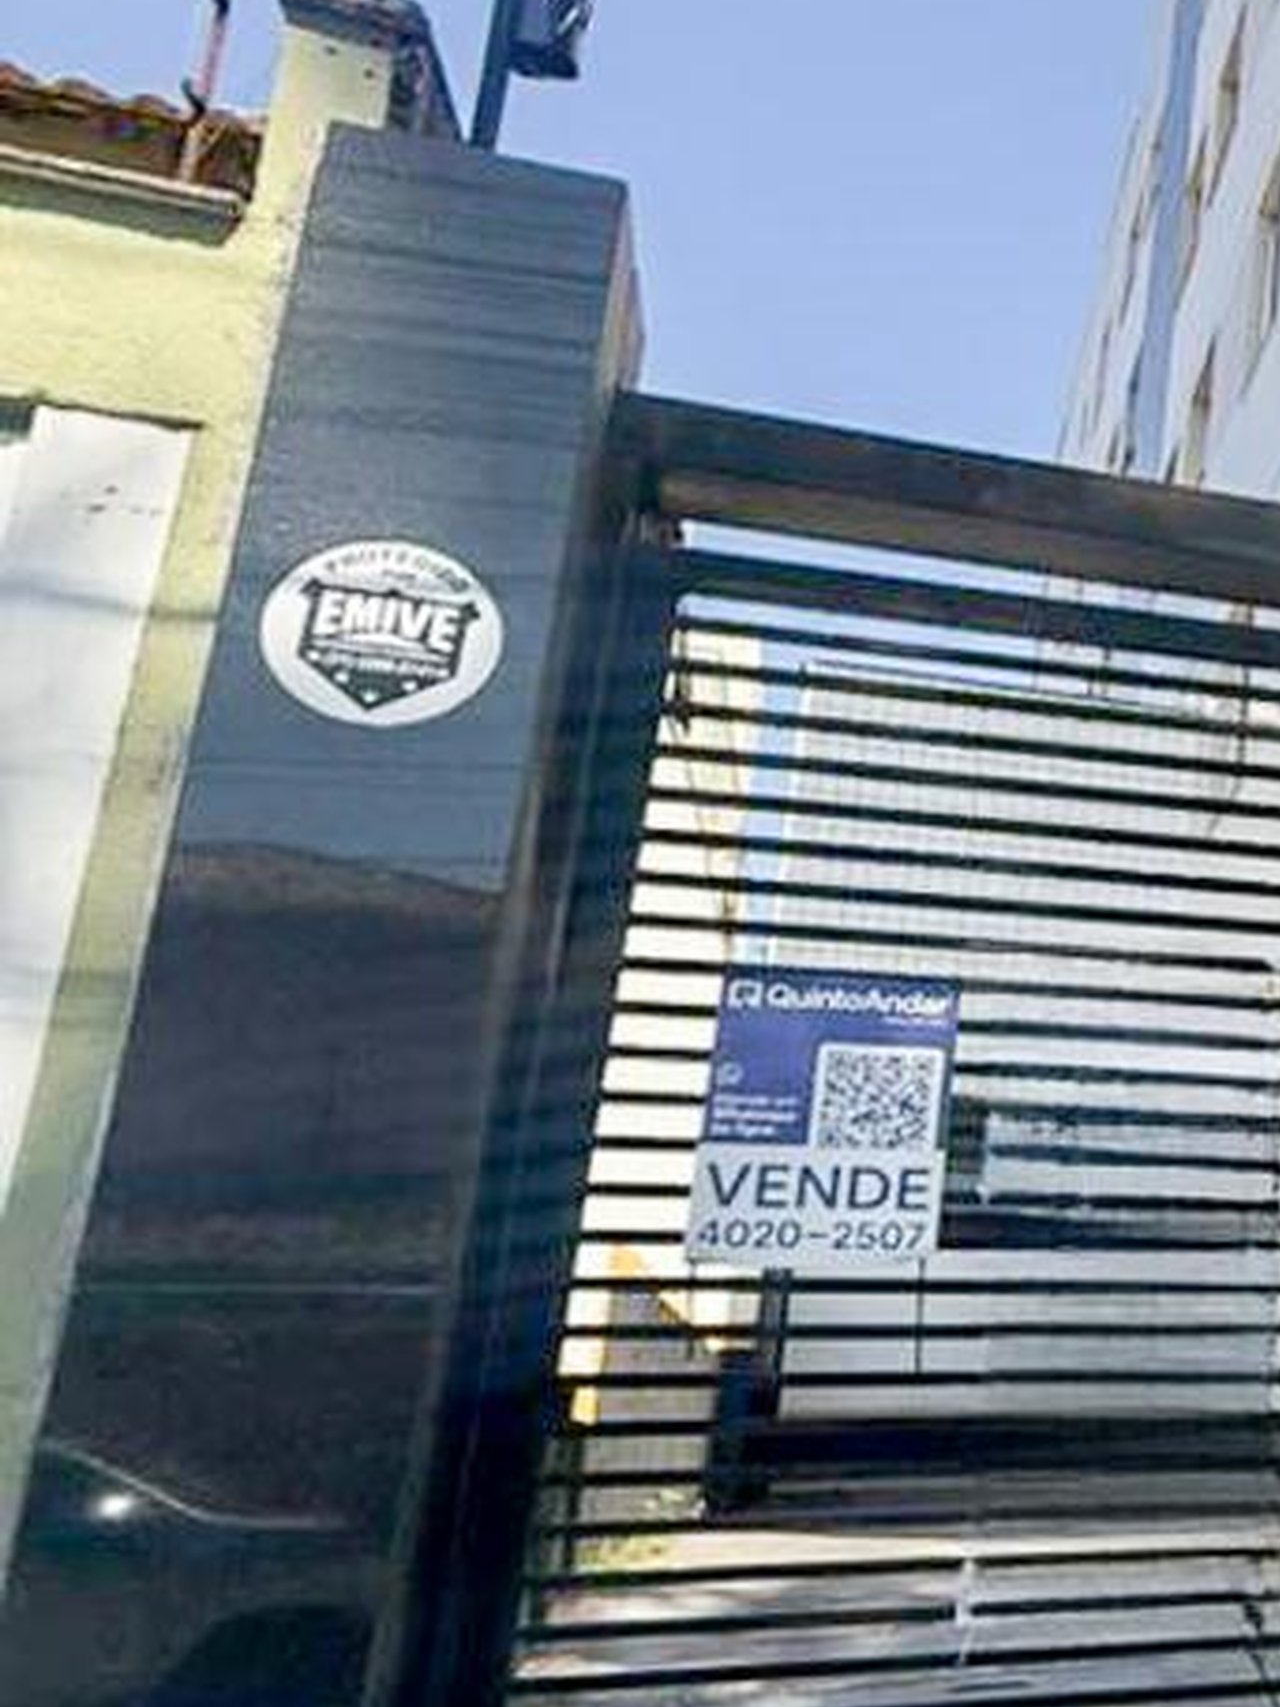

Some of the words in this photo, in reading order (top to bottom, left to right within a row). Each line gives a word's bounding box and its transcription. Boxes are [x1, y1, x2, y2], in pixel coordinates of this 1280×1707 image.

[313, 590, 461, 652] EMIVE
[766, 981, 948, 1017] QuintoAndar
[707, 1162, 930, 1210] VENDE
[698, 1217, 926, 1251] 4020-2507
